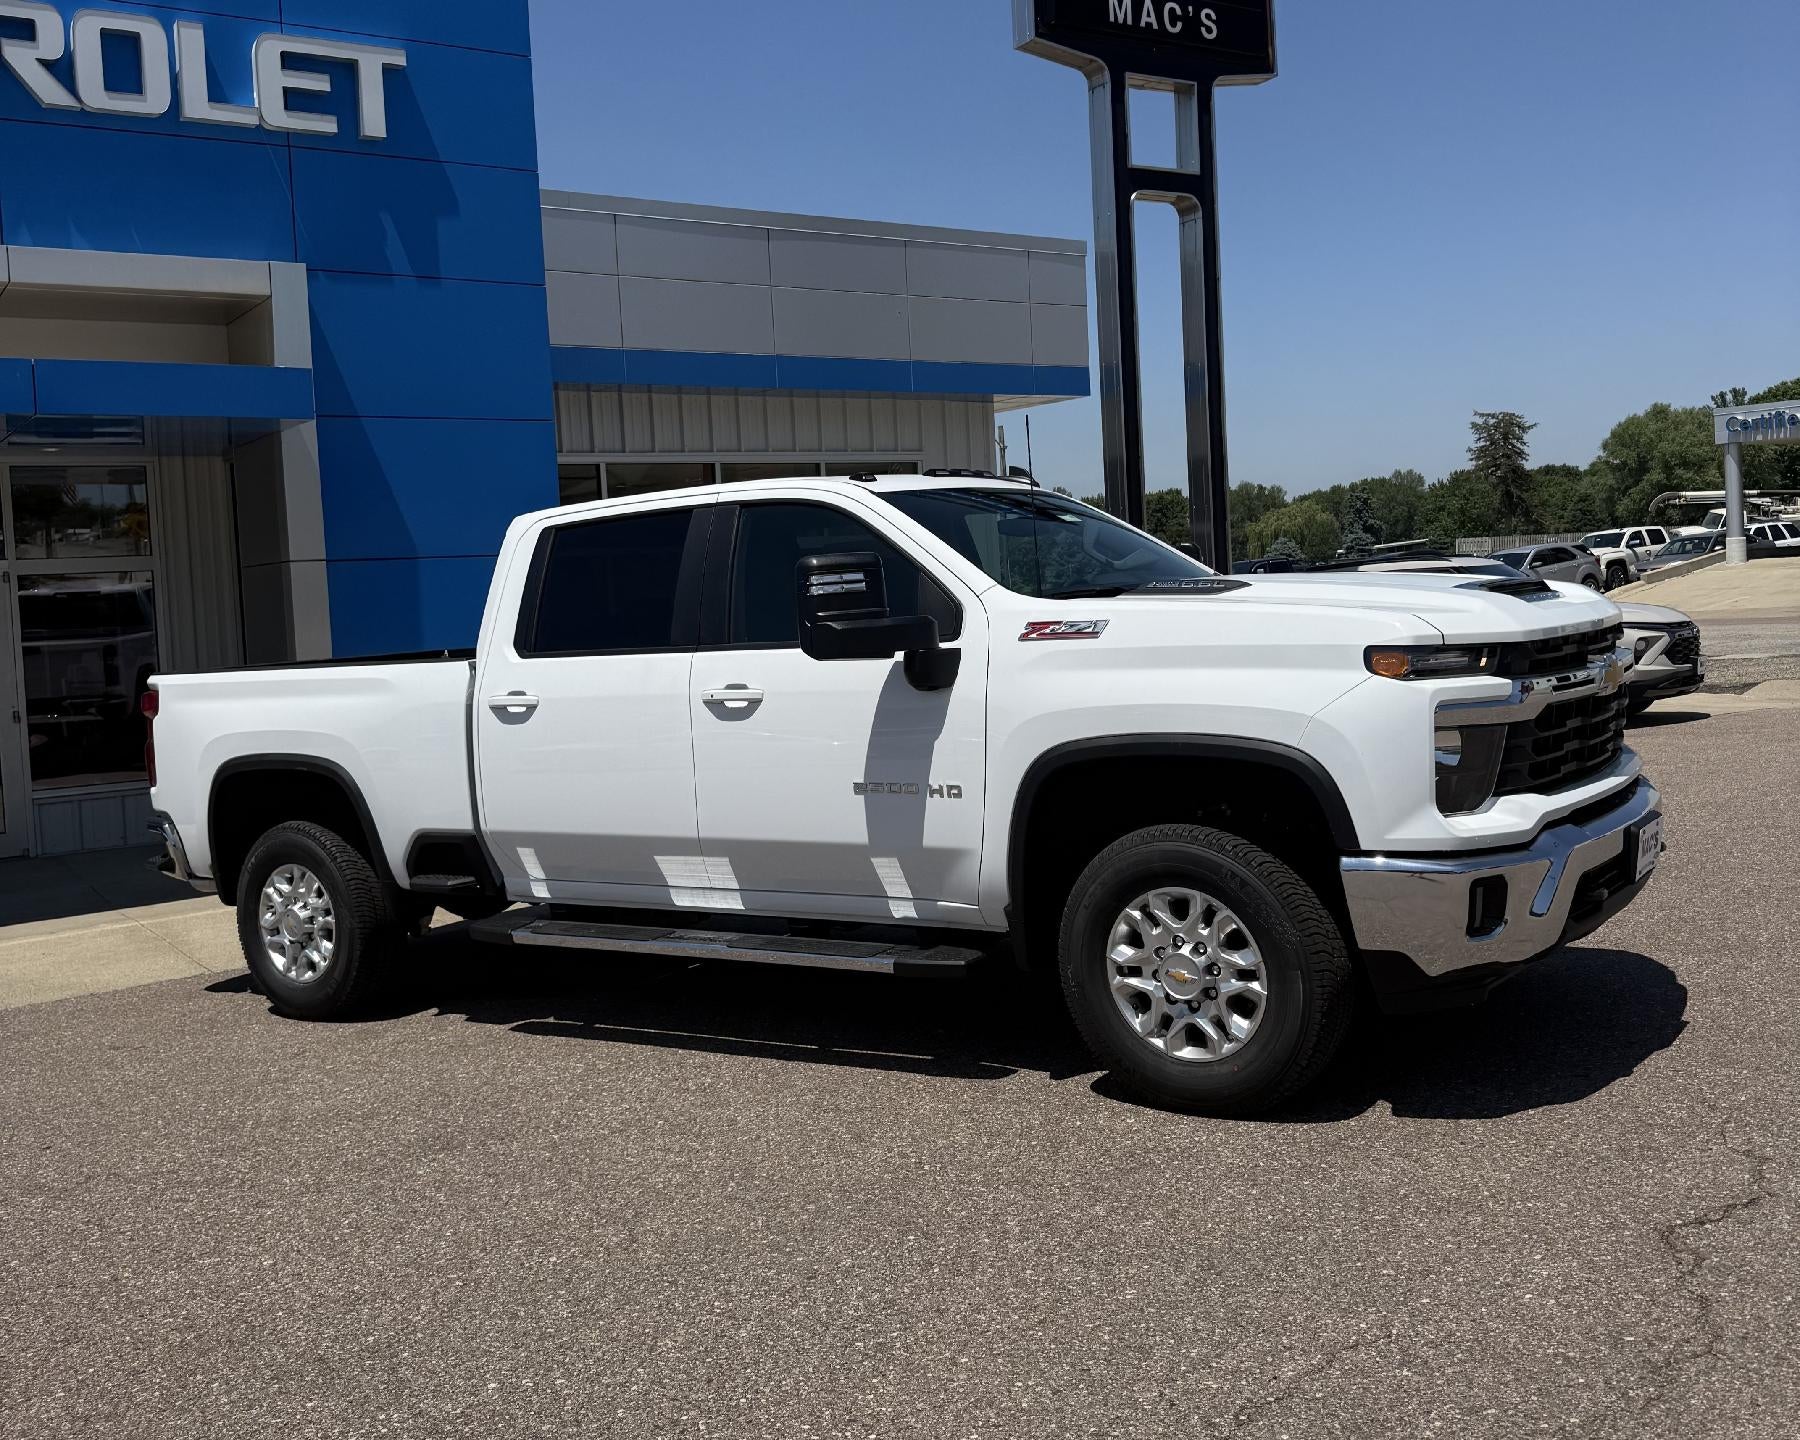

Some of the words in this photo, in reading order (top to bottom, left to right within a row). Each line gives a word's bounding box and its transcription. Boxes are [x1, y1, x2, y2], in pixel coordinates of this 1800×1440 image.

[1108, 0, 1219, 40] MAC'S
[1726, 410, 1800, 432] Certifie
[927, 783, 963, 799] HD
